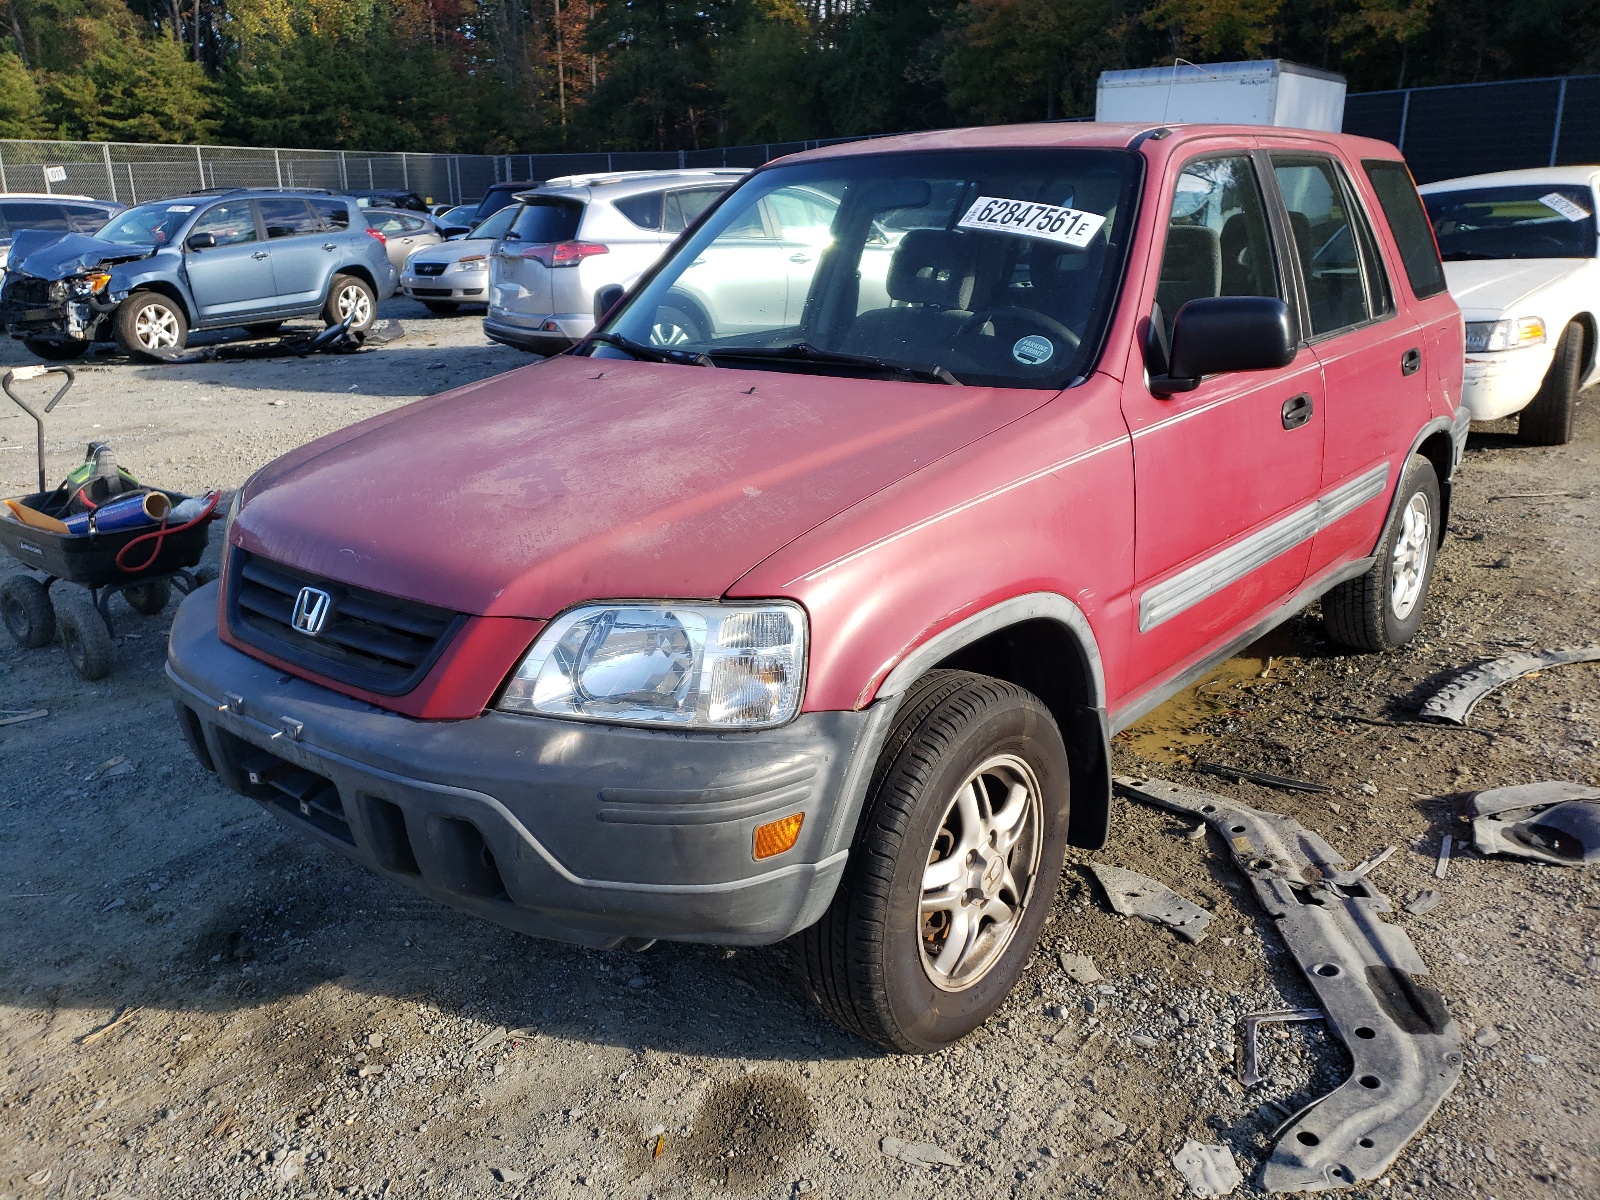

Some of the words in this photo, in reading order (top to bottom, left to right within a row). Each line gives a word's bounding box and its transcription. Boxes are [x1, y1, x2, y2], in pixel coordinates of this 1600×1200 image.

[977, 199, 1083, 236] 62847561
[1020, 345, 1044, 357] PERMIT
[1022, 339, 1049, 353] PARKING
